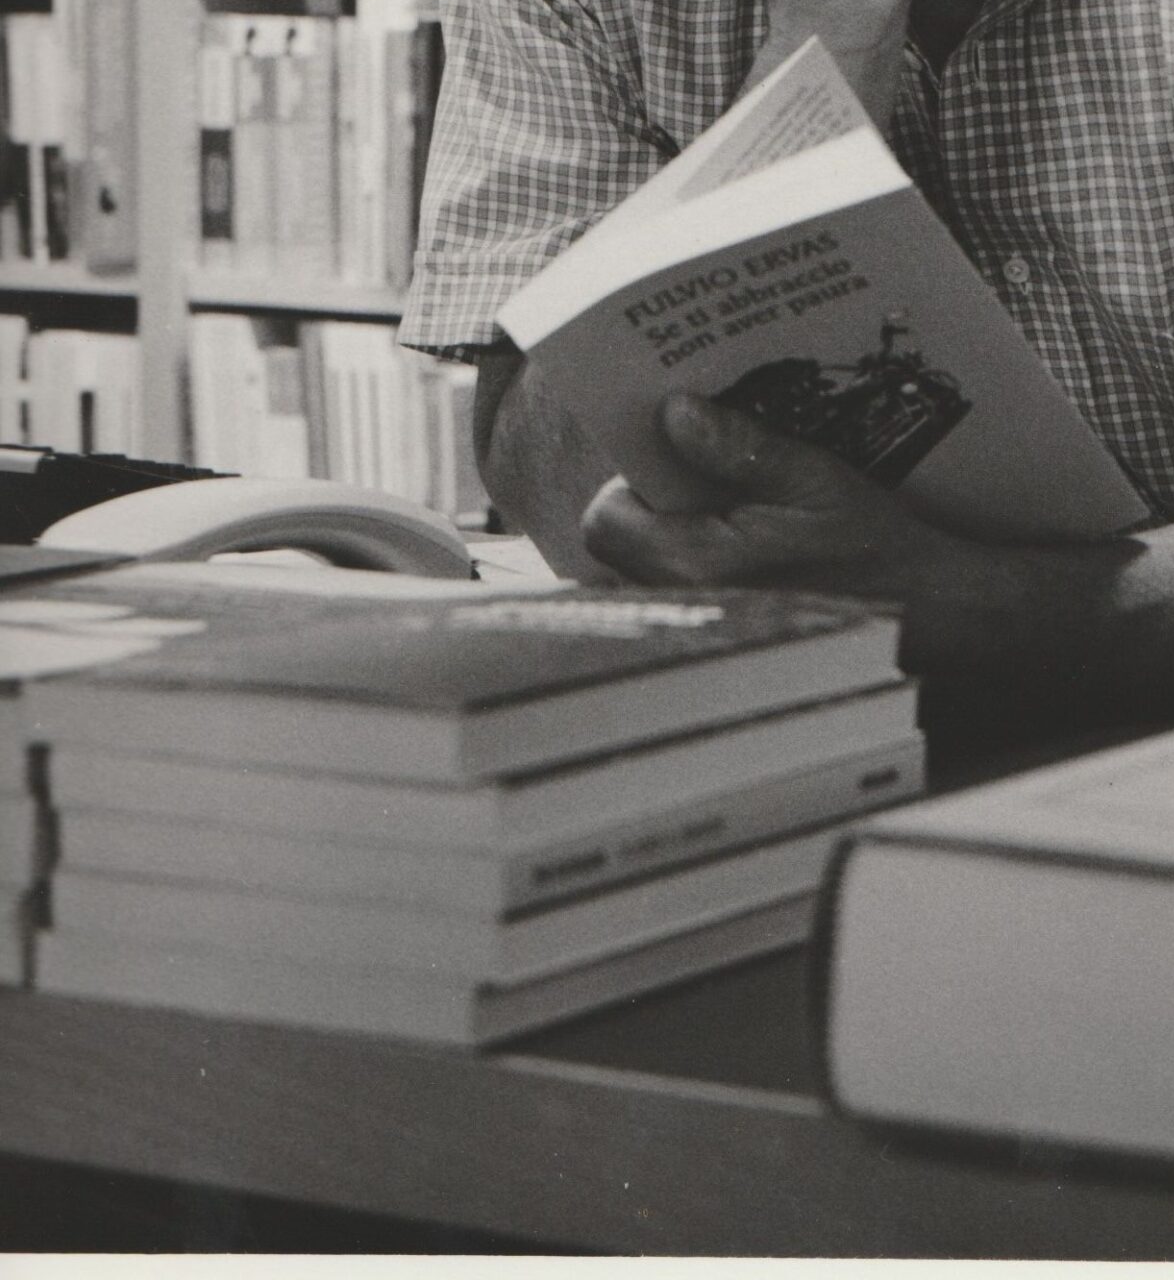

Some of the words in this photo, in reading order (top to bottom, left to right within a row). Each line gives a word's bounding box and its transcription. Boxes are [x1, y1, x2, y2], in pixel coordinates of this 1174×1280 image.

[624, 267, 738, 327] FULVIO
[743, 229, 839, 277] ERVAS
[646, 322, 681, 348] Se
[685, 306, 711, 329] ti
[717, 258, 851, 317] abbraccio
[659, 331, 717, 368] non
[724, 303, 780, 337] aver
[787, 274, 869, 317] paura
